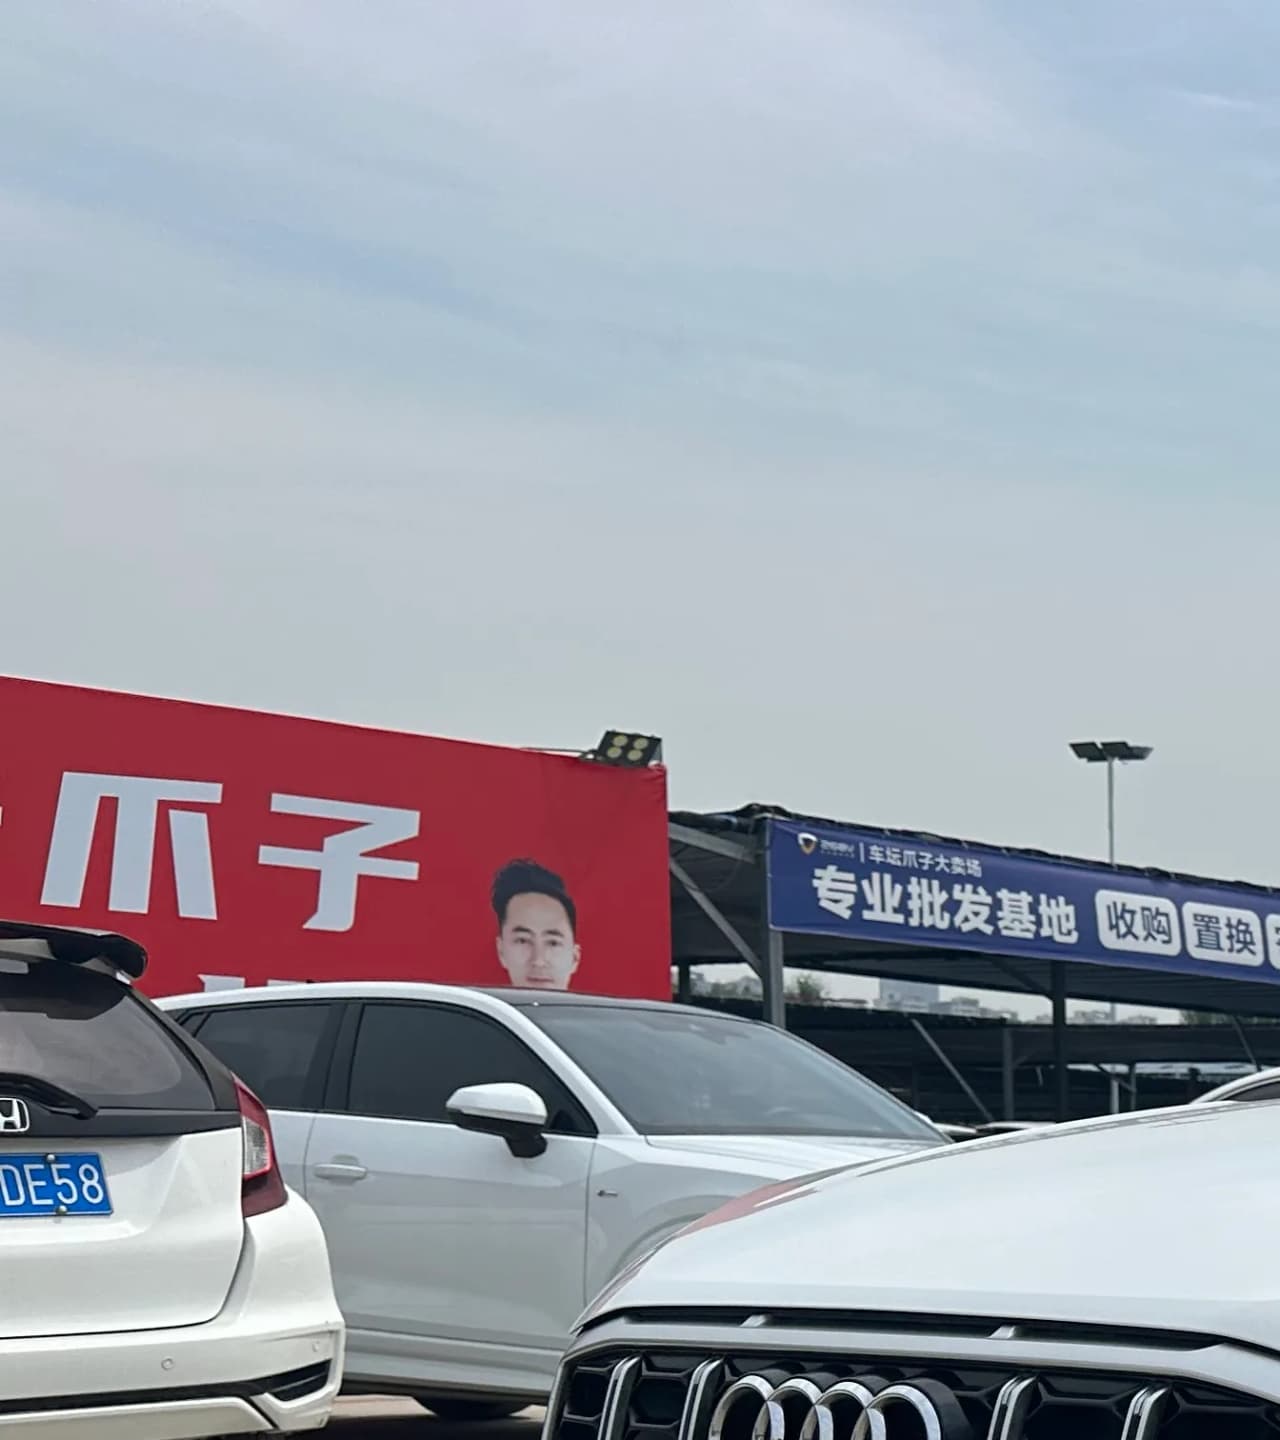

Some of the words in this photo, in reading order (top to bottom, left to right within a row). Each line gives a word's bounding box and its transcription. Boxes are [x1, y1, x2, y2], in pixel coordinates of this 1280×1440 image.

[39, 771, 421, 932] 爪子
[869, 845, 982, 878] 车坛爪子大卖场
[812, 865, 1079, 944] 专业批发基地
[1106, 901, 1171, 944] 收购
[1193, 913, 1256, 956] 置换
[0, 1163, 105, 1206] DE58
